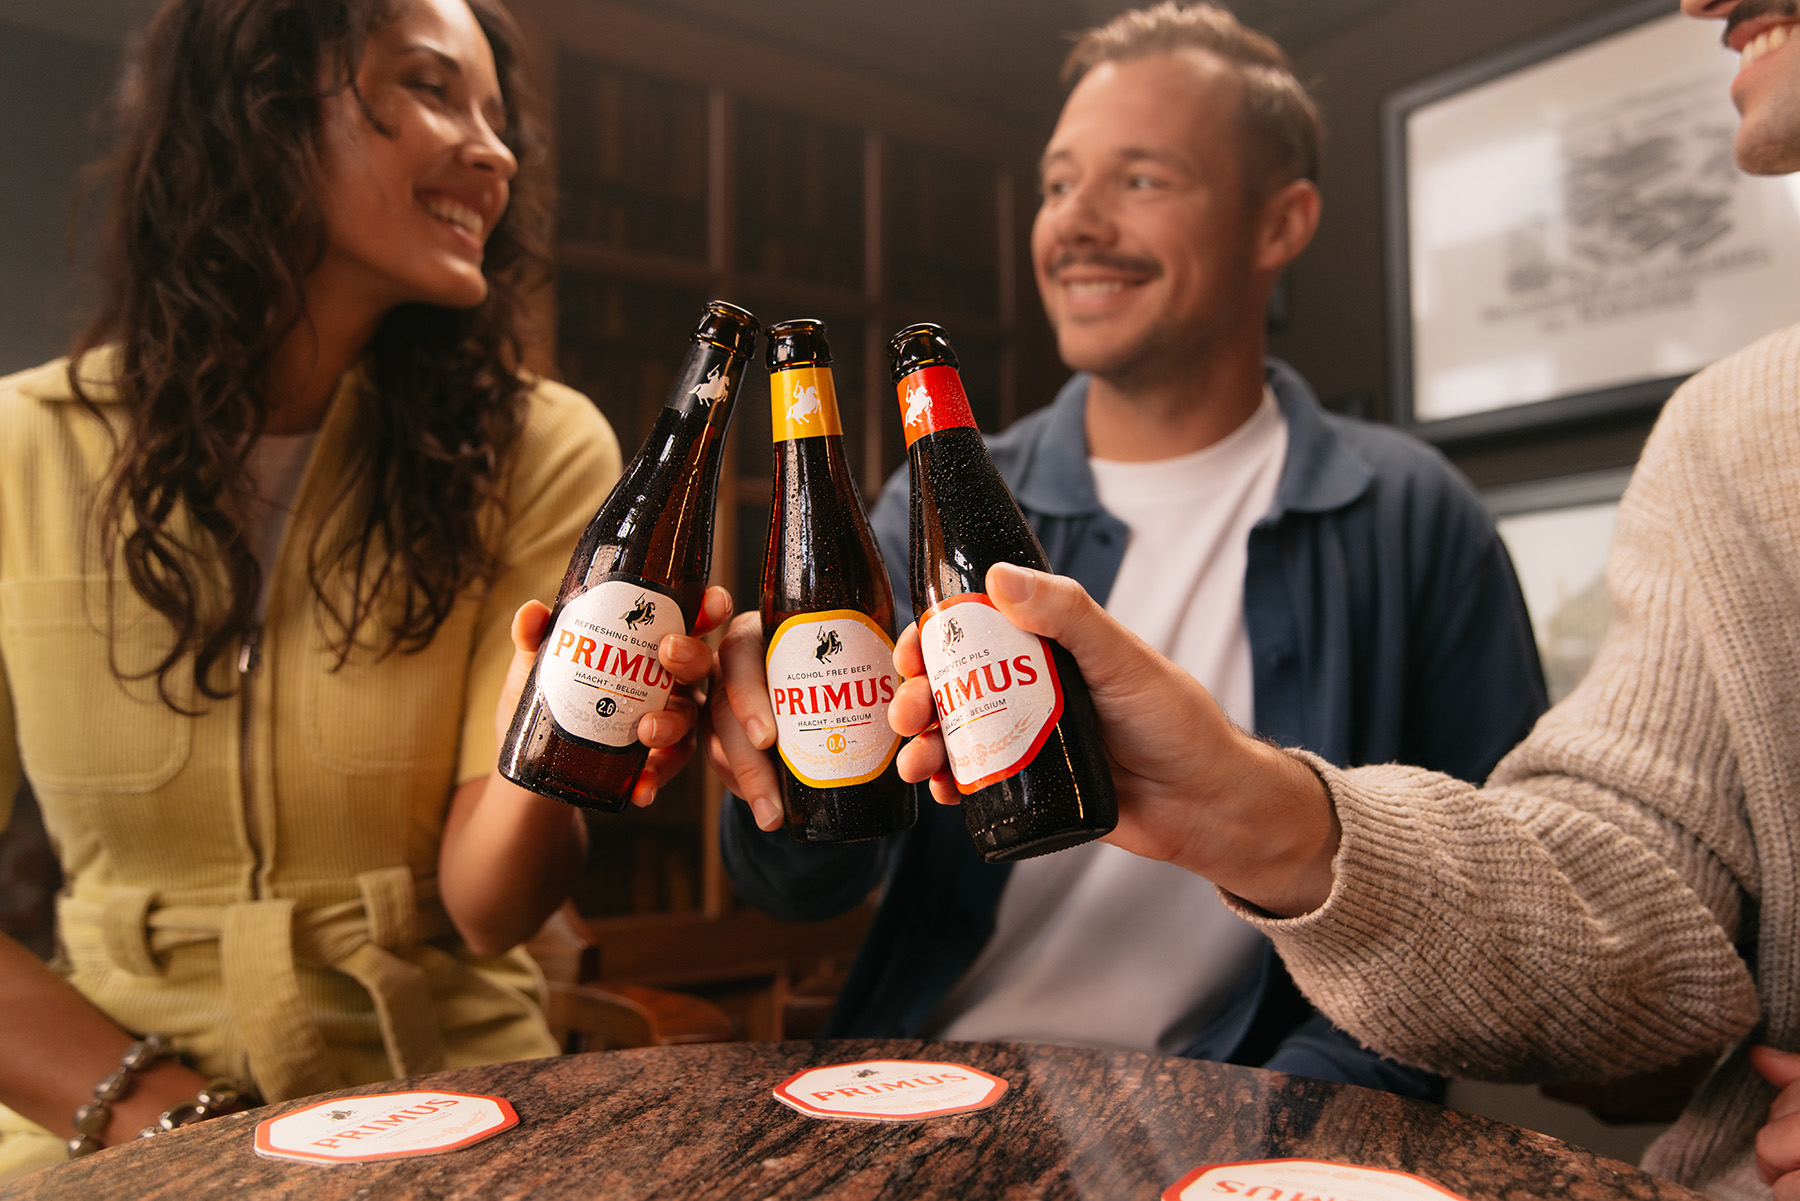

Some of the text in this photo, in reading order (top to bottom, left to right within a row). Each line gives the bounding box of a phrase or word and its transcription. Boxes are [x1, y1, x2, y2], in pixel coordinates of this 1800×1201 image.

[574, 618, 659, 651] REFRESHING BLOND
[553, 629, 672, 690] PRIMUS
[969, 648, 990, 661] PILS
[575, 670, 608, 687] HAACHT
[615, 683, 648, 698] BELGIUM
[787, 664, 872, 681] ALCOHOL FREE BEER
[774, 675, 894, 716] PRIMUS
[933, 655, 1038, 722] RIMUS
[597, 699, 615, 715] 2.6
[797, 718, 828, 727] HAACHT
[836, 713, 872, 724] BELGIUM
[969, 698, 1007, 717] BELGIUM
[828, 736, 845, 751] 0.4
[811, 1073, 968, 1101] PRIMUS
[312, 1099, 459, 1149] PRIMUS
